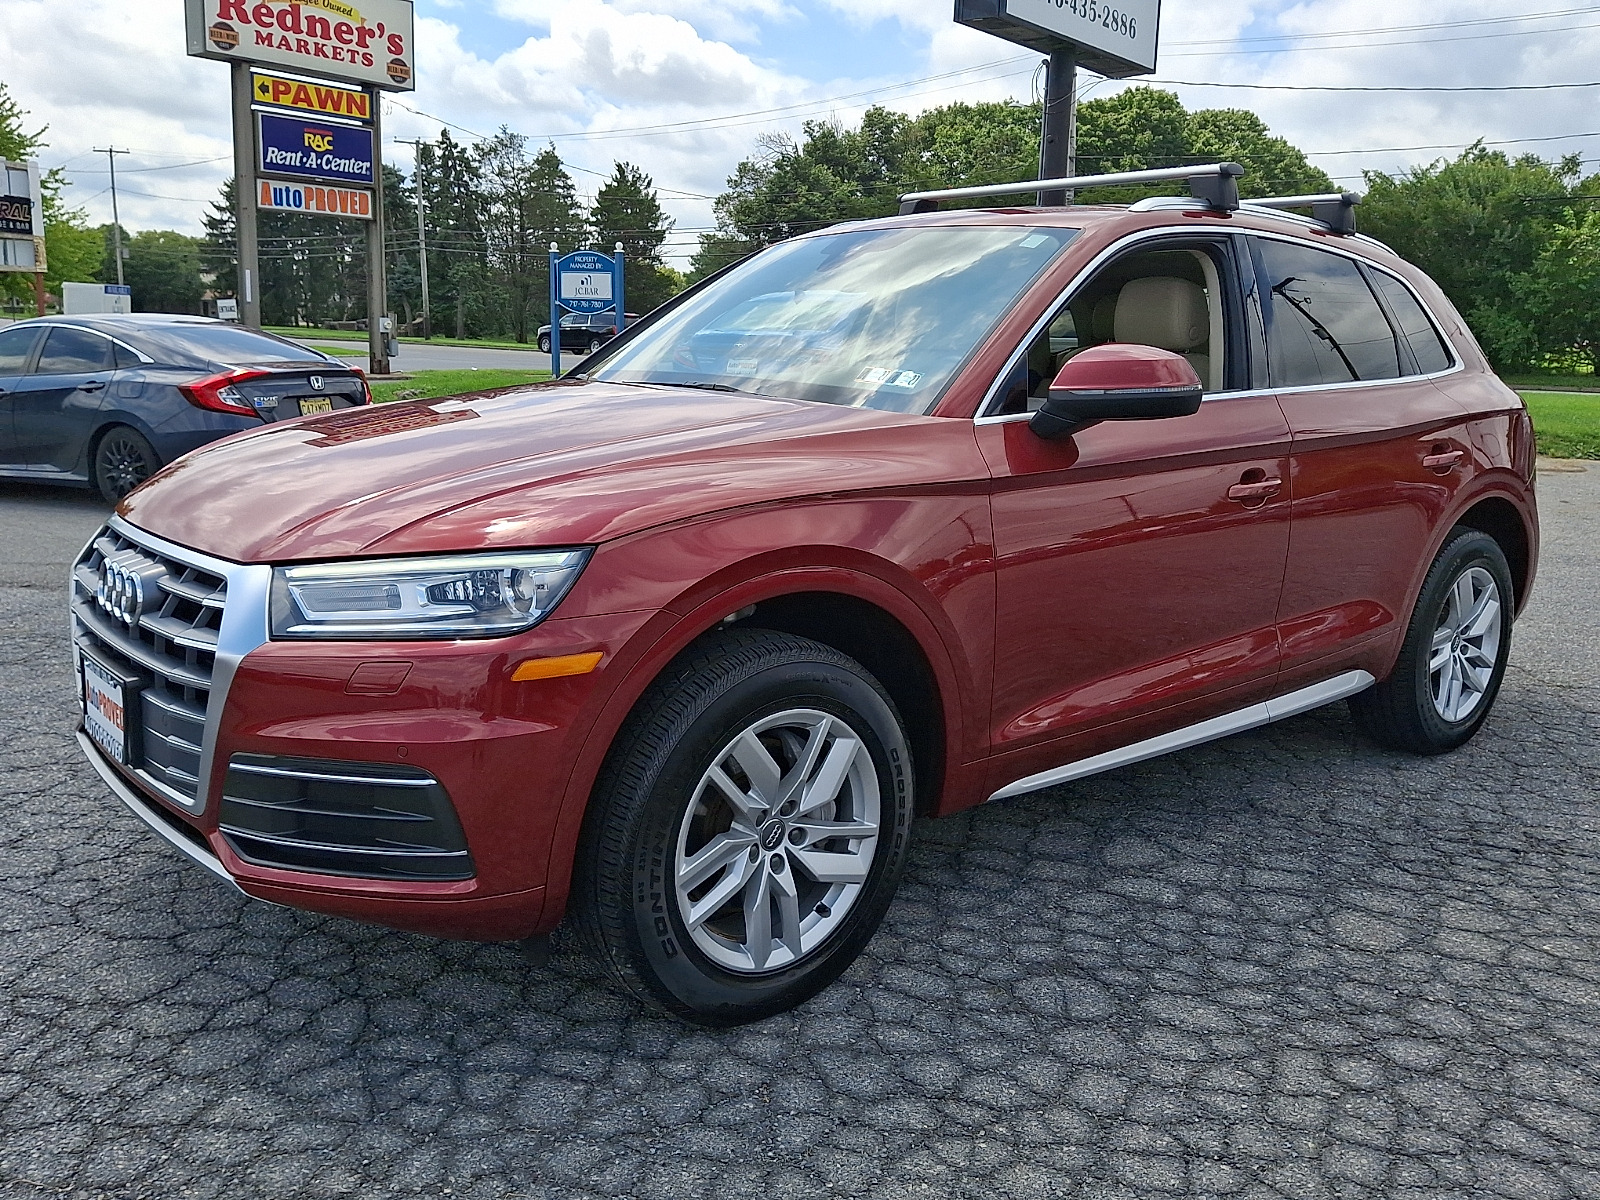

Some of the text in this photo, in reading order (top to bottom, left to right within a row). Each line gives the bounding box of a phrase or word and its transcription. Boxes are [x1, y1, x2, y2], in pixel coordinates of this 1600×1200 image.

[216, 0, 405, 55] Redner's
[1047, 0, 1137, 39] -435-2886
[254, 30, 374, 67] MARKETS
[271, 79, 367, 116] PAWN
[304, 133, 334, 152] RAC
[260, 181, 370, 216] AutoPROVED
